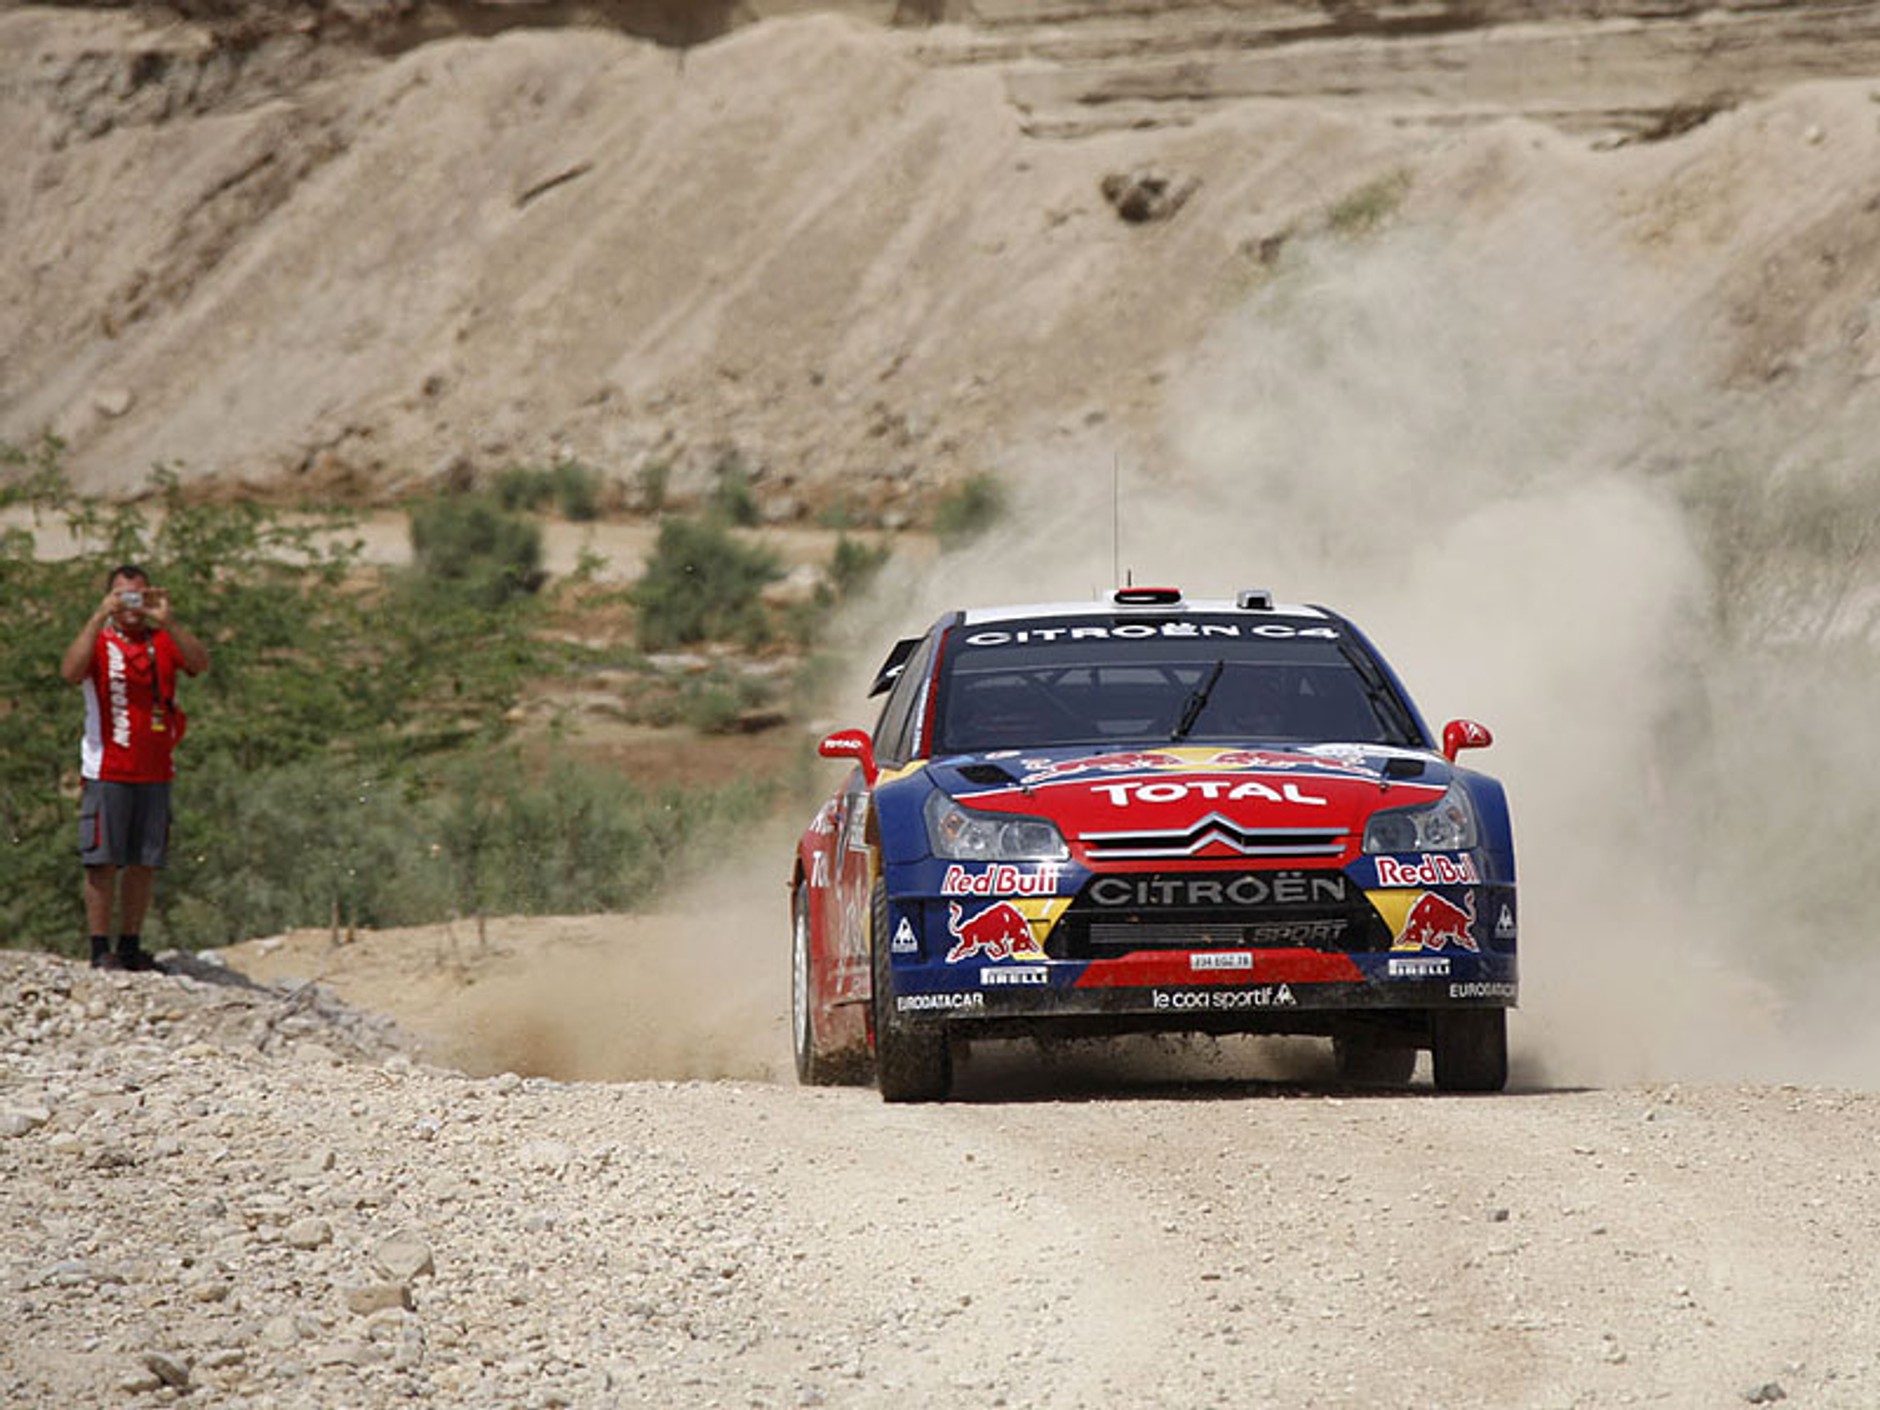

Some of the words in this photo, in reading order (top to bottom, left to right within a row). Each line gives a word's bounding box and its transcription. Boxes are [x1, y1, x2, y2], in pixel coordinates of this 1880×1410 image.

[965, 622, 1240, 646] CITROËN
[1252, 625, 1340, 639] C4
[1090, 781, 1328, 806] TOTAL
[941, 864, 996, 895] Red
[994, 864, 1057, 895] Bull
[1375, 853, 1439, 886] Red
[1089, 871, 1347, 905] CITROËN
[1253, 921, 1348, 943] SPORT
[980, 967, 1047, 985] PIRELLI
[1389, 958, 1450, 975] PIRELLI
[1152, 989, 1169, 1008] le
[1213, 986, 1272, 1010] sportif
